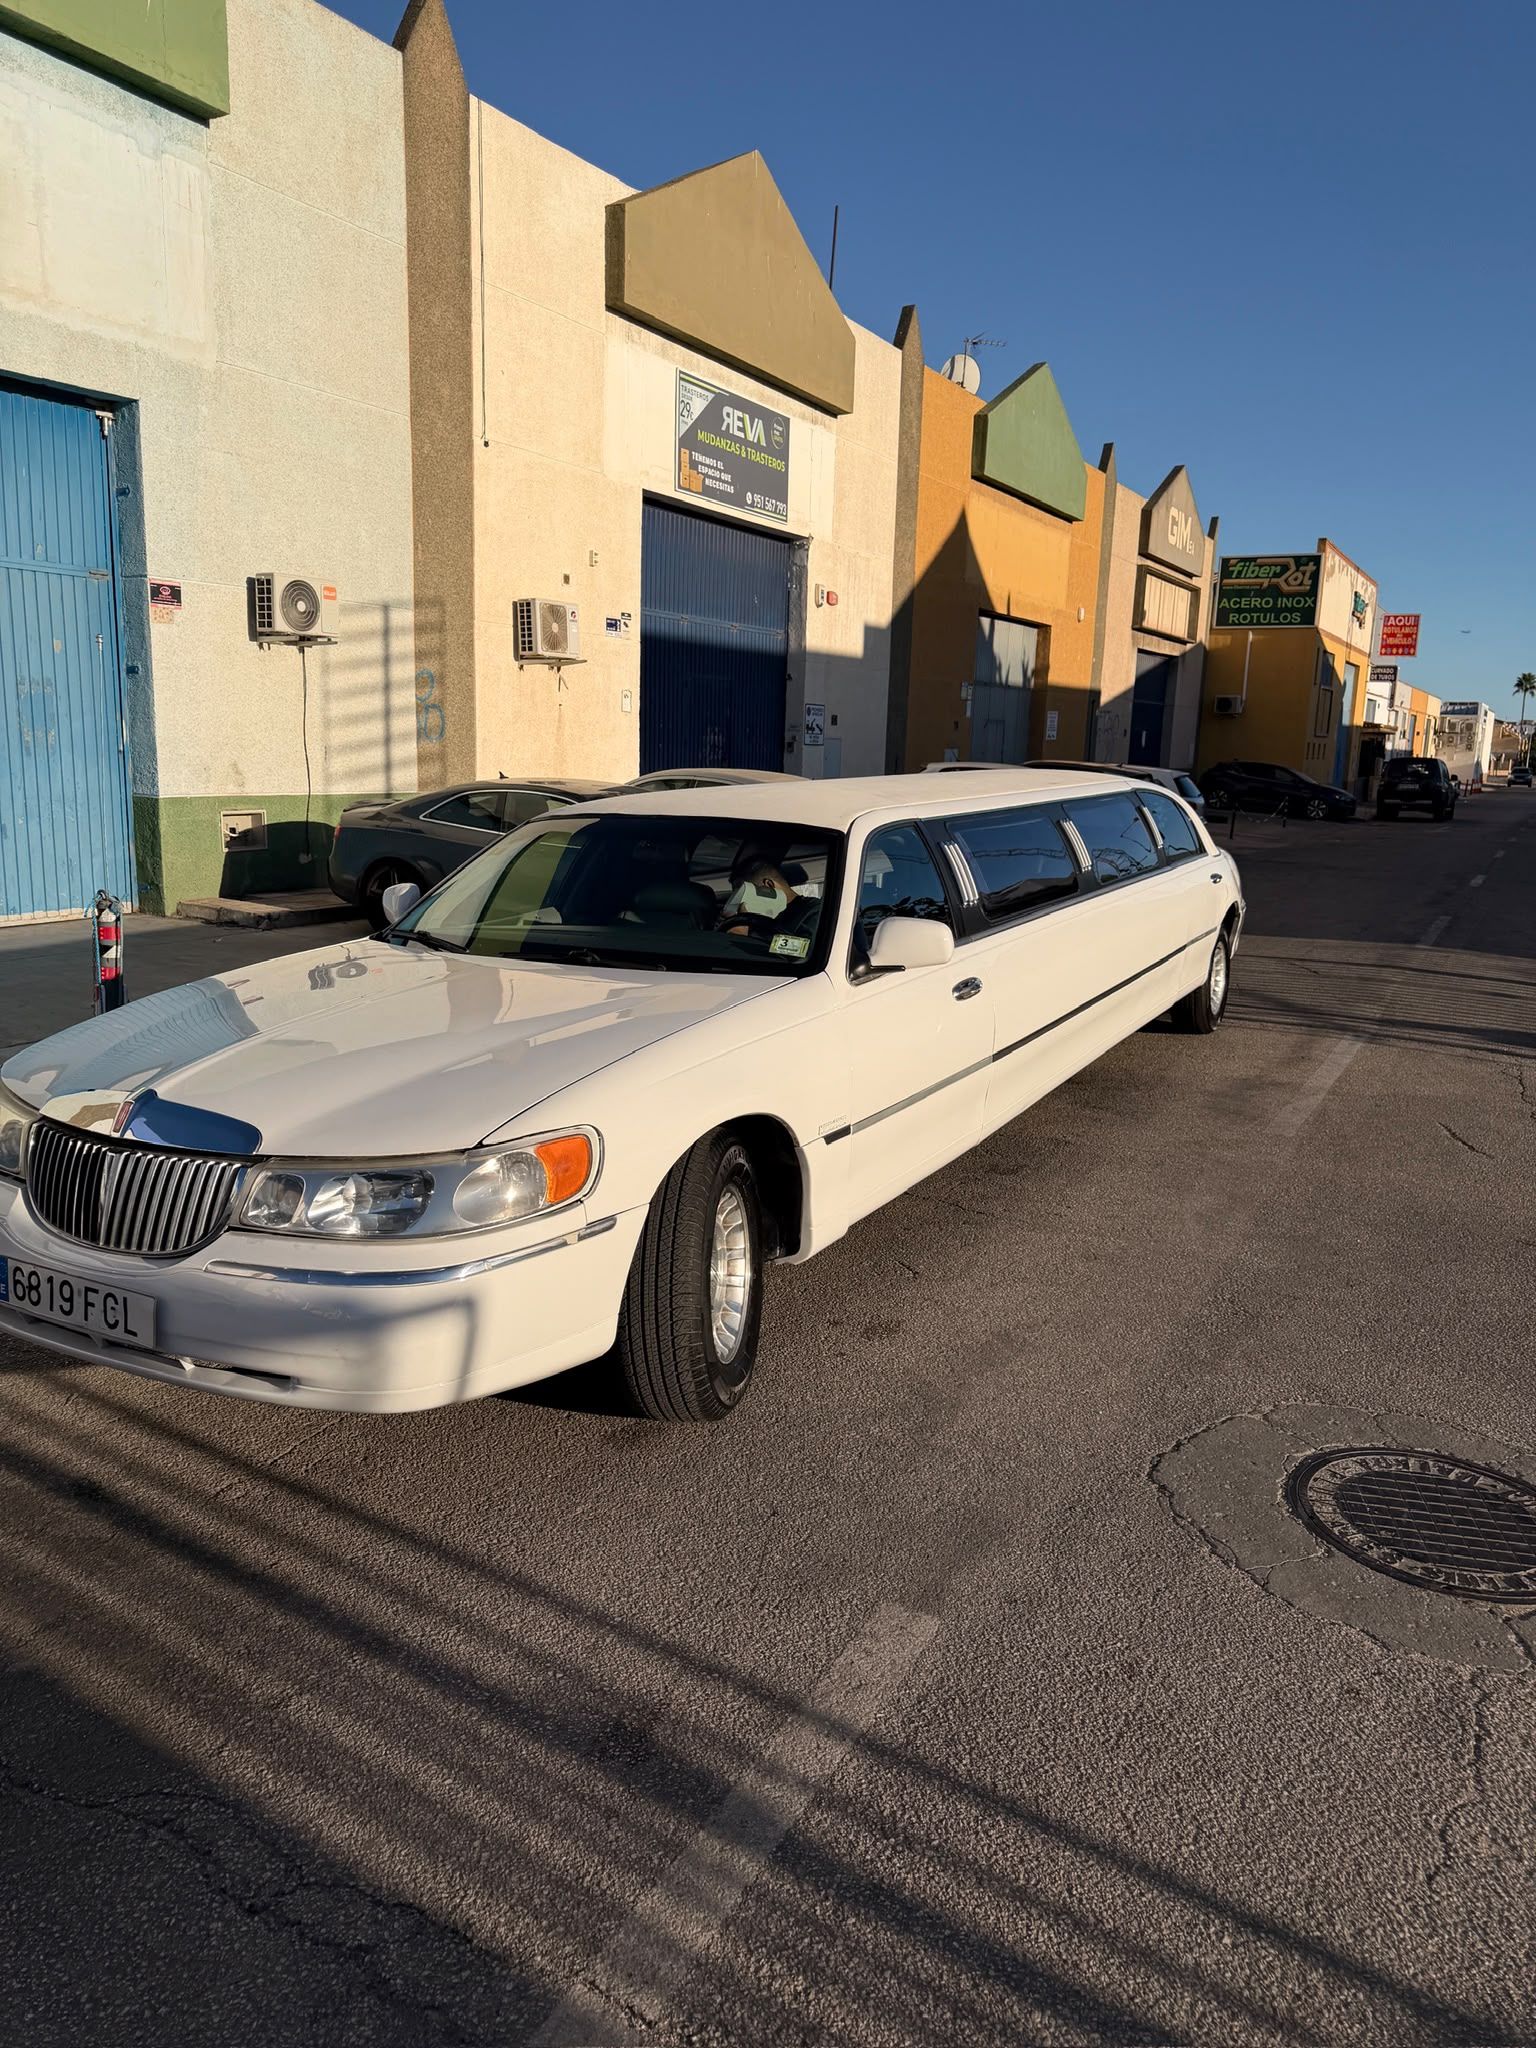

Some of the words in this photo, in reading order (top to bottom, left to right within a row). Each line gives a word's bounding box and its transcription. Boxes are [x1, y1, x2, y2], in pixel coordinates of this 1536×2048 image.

[697, 429, 741, 456] MUDANZAS
[740, 445, 747, 458] &
[747, 447, 785, 472] TRASTEROS
[691, 451, 717, 468] TENEMOS
[717, 461, 725, 470] EL
[698, 464, 720, 479] ESPACIO
[720, 472, 732, 483] QUE
[705, 477, 734, 494] NECESITAS
[753, 493, 764, 509] 951
[1219, 597, 1274, 609] ACERO
[1276, 596, 1316, 609] INOX
[1228, 612, 1302, 624] ROTULOS
[12, 1265, 75, 1317] 6819
